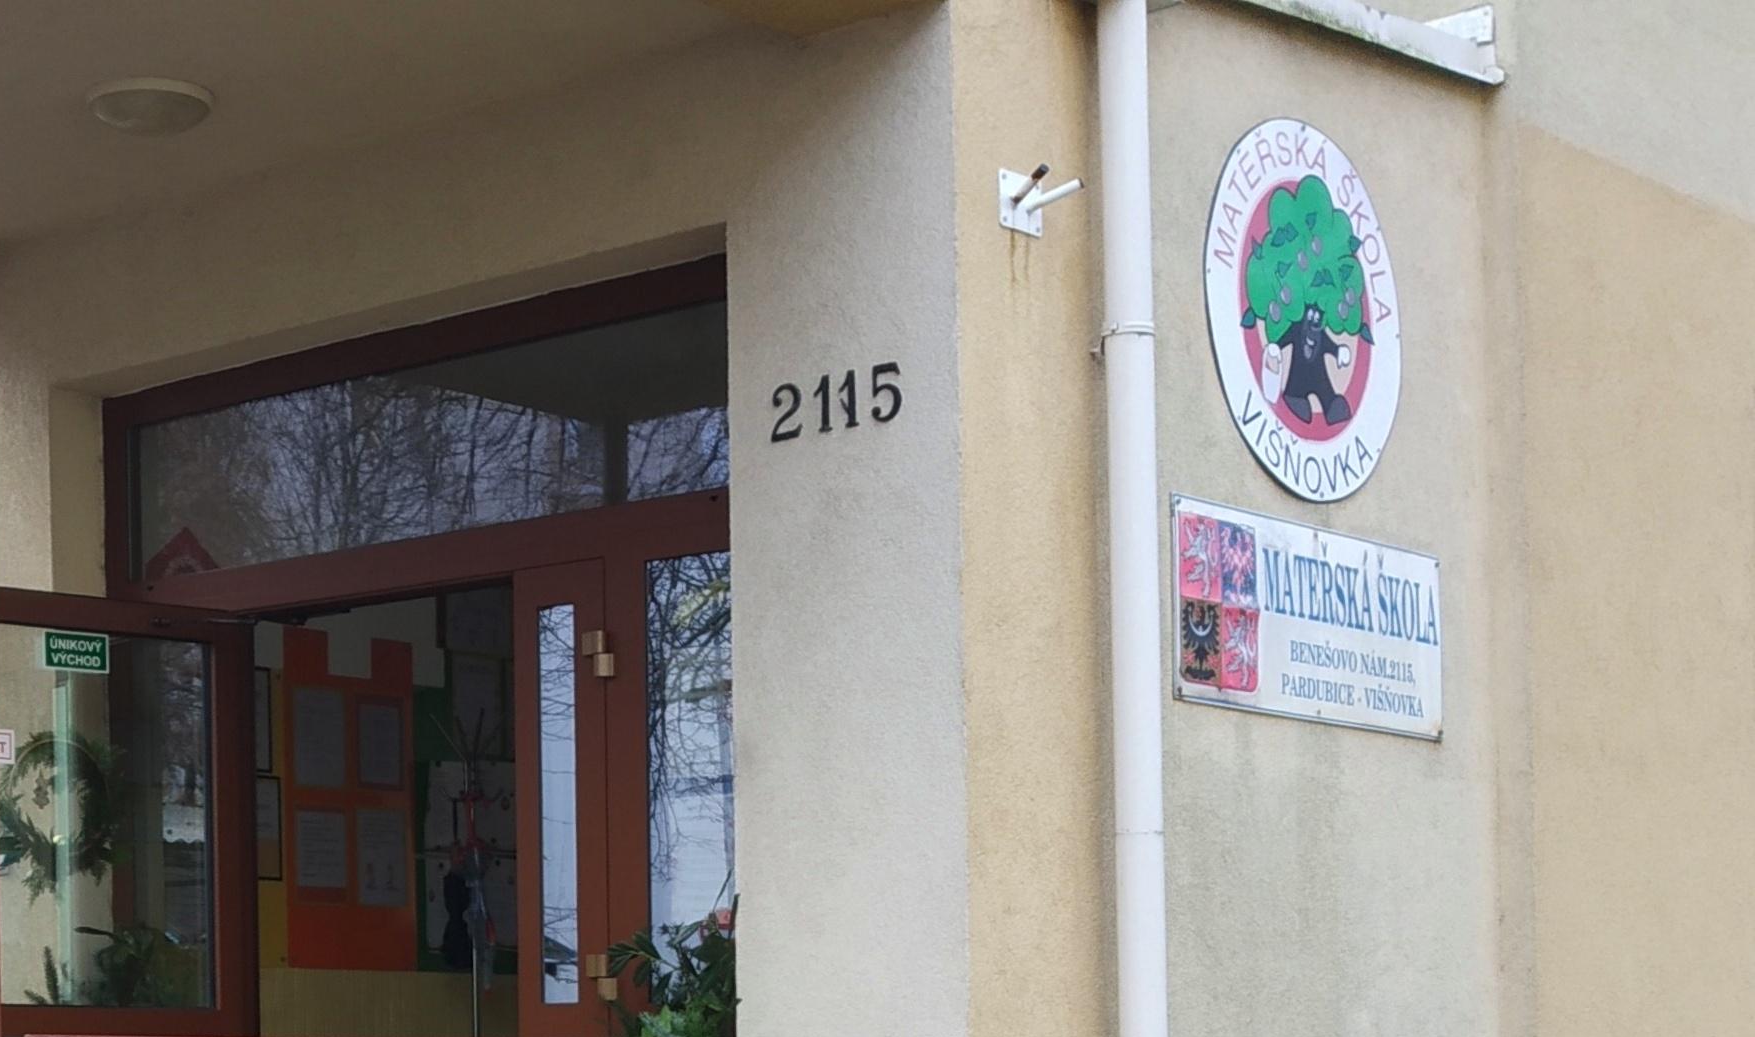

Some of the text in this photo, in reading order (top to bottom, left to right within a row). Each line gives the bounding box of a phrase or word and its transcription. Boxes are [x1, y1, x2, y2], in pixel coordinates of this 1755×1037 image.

[1214, 130, 1392, 324] MATEŘSKÁ ŠKOLA
[770, 361, 903, 444] 2115
[1242, 389, 1374, 494] VIŠŇOVKA
[1261, 540, 1439, 647] MATEŘSKÁ ŠKOLA
[49, 634, 103, 653] ÚNIKOVÝ
[50, 650, 101, 668] VÝCHOD
[1290, 639, 1358, 672] BENEŠOVO
[1281, 672, 1355, 706] PARDUBICE
[1364, 683, 1424, 719] VIŠŇOVKA
